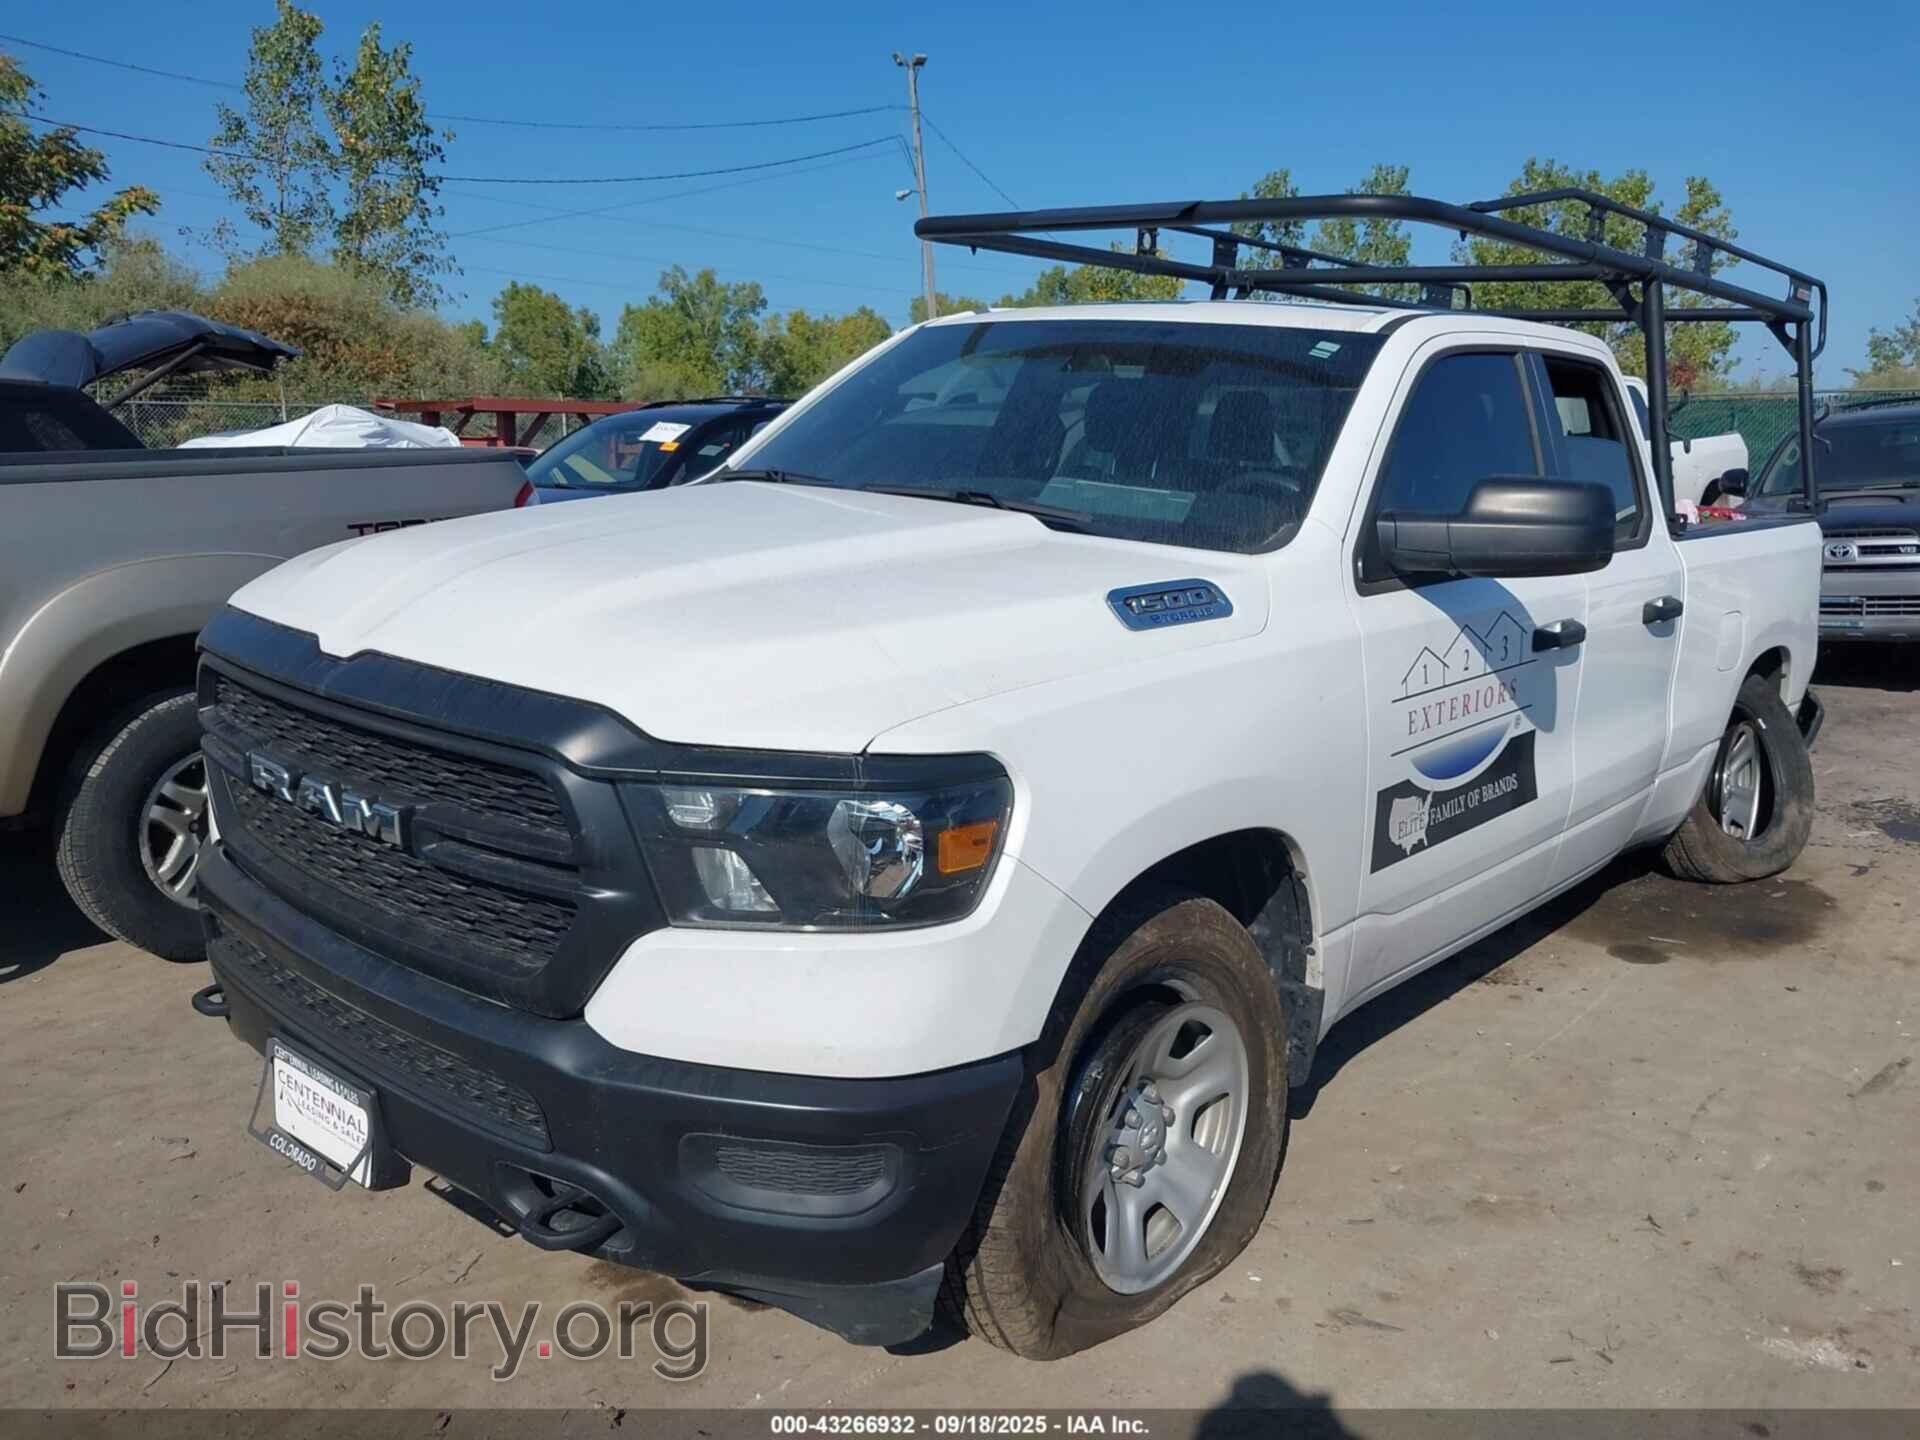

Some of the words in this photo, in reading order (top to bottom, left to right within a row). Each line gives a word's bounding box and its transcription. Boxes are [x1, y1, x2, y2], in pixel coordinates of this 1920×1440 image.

[1123, 587, 1217, 615] 1500
[1422, 664, 1429, 684] 1
[1463, 649, 1470, 671] 2
[1500, 635, 1508, 661] 3
[1407, 678, 1518, 736] EXTERIORS
[247, 752, 402, 846] RAM
[1429, 795, 1467, 826] FAMILY
[1467, 788, 1482, 809] OF
[1482, 774, 1519, 803] BRANDS
[278, 1069, 366, 1136] CENTENNIAL
[269, 1133, 317, 1171] COLORADO
